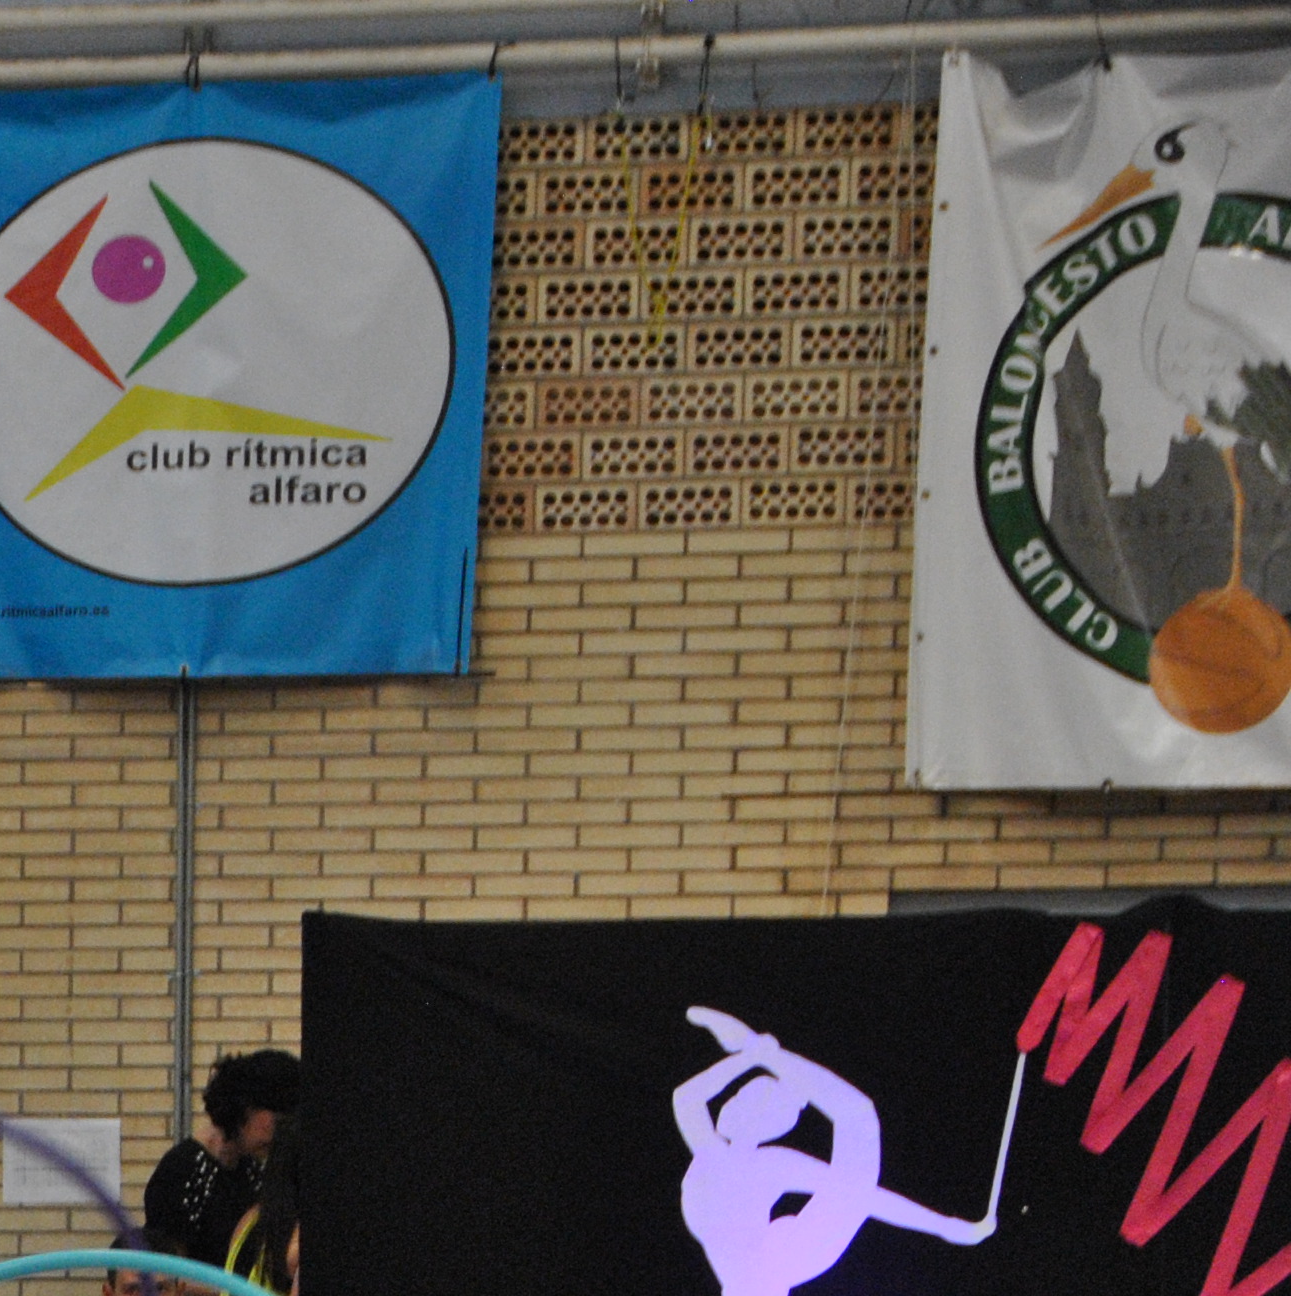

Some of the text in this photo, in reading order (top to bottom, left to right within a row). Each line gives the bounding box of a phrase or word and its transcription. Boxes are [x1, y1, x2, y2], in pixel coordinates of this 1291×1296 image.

[1012, 537, 1119, 652] CLUB
[1246, 204, 1291, 250] A
[125, 437, 368, 472] club rítmica
[248, 474, 368, 505] alfaro
